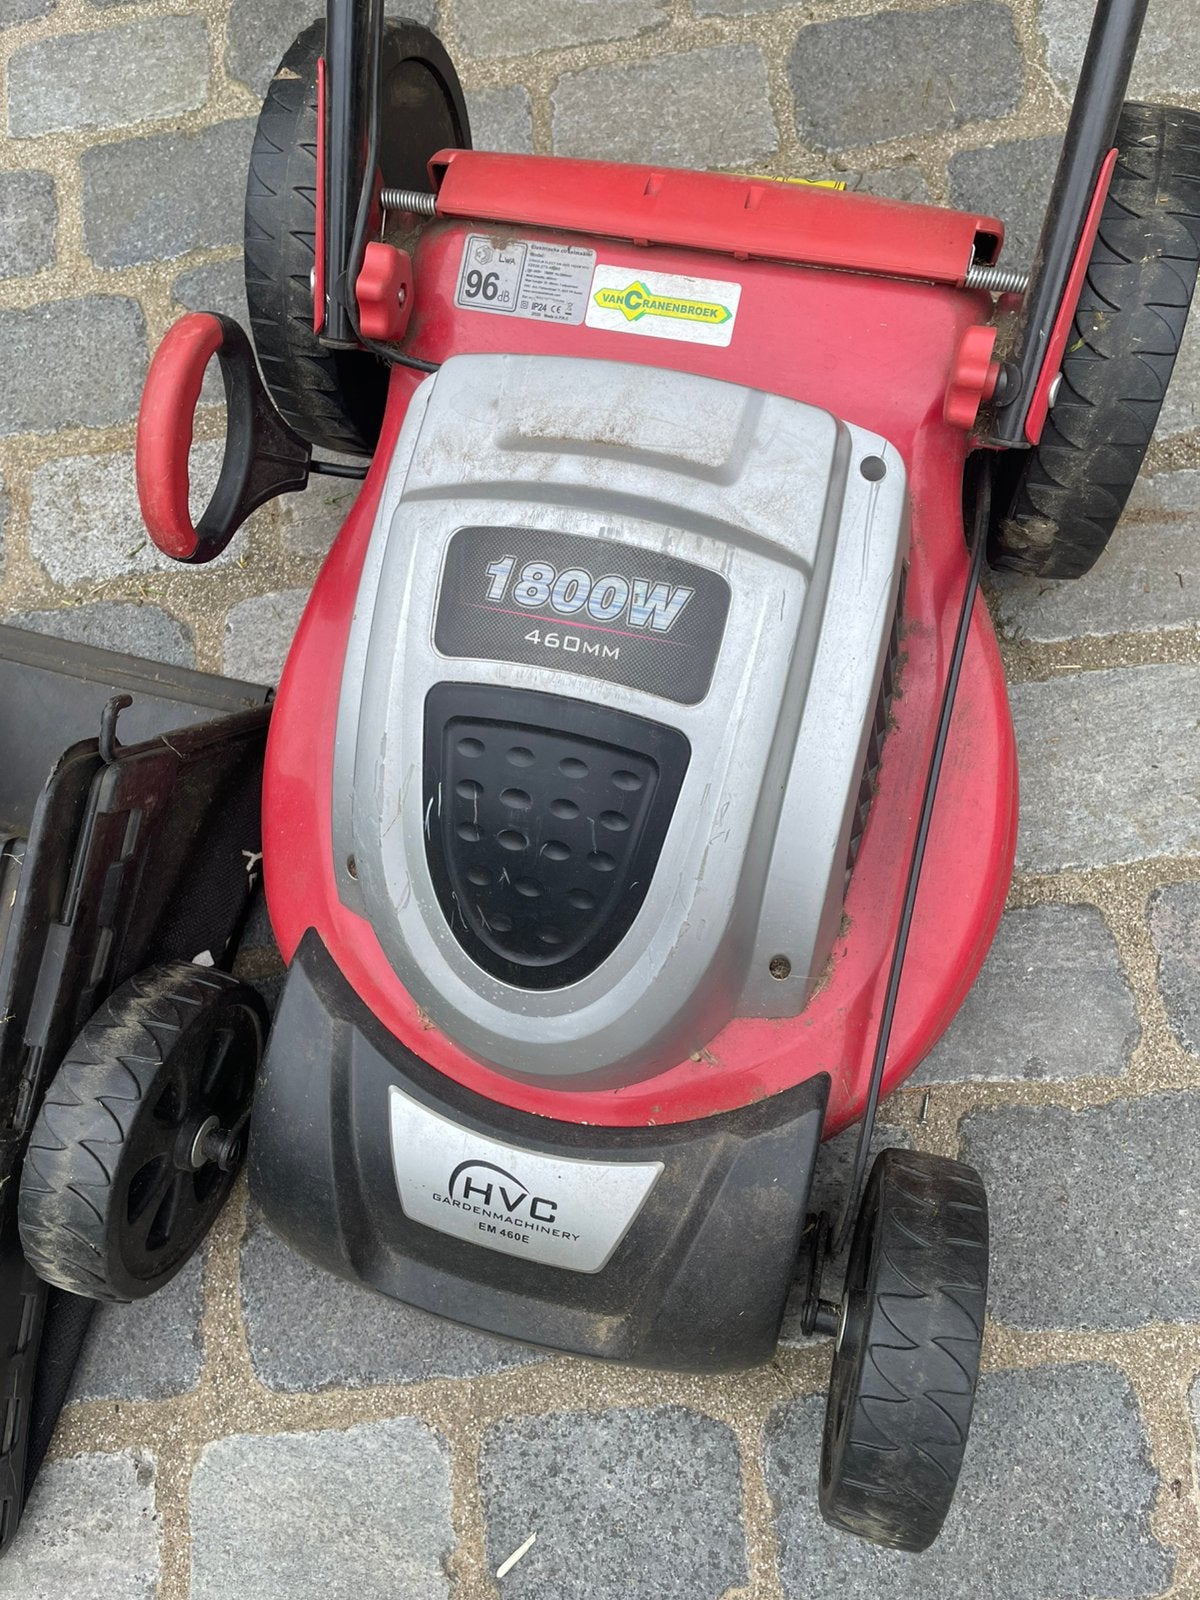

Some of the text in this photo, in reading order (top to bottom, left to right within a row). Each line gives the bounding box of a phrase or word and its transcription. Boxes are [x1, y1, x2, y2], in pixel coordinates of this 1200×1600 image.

[465, 269, 500, 300] 96
[497, 290, 510, 302] dB
[531, 302, 547, 312] IP24
[486, 554, 695, 633] 1800W
[524, 629, 620, 660] 460MM
[462, 1176, 558, 1223] HVC
[432, 1192, 580, 1242] GARDENMACHINERY
[478, 1221, 530, 1244] EM 460E
